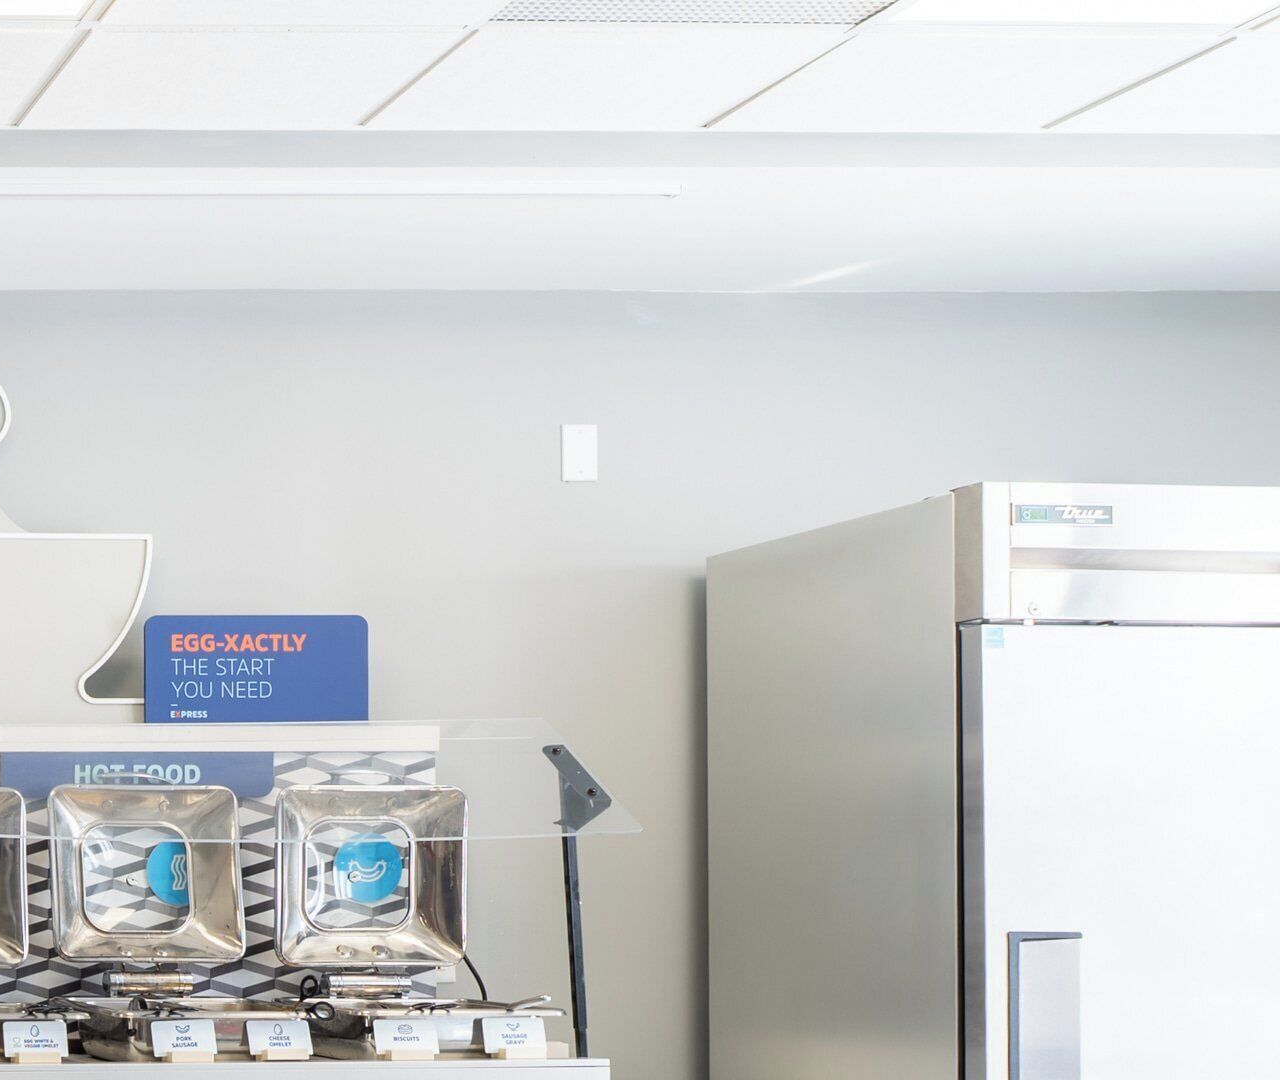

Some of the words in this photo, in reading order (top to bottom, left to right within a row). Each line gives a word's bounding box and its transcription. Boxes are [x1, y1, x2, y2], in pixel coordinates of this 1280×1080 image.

[170, 633, 307, 653] EGG-XACTLY
[170, 658, 209, 676] THE
[215, 658, 275, 676] START
[170, 681, 213, 699] YOU
[220, 681, 273, 699] NEED
[170, 710, 208, 719] EXPRESS
[74, 764, 125, 785] HOT
[133, 764, 202, 785] FOOD
